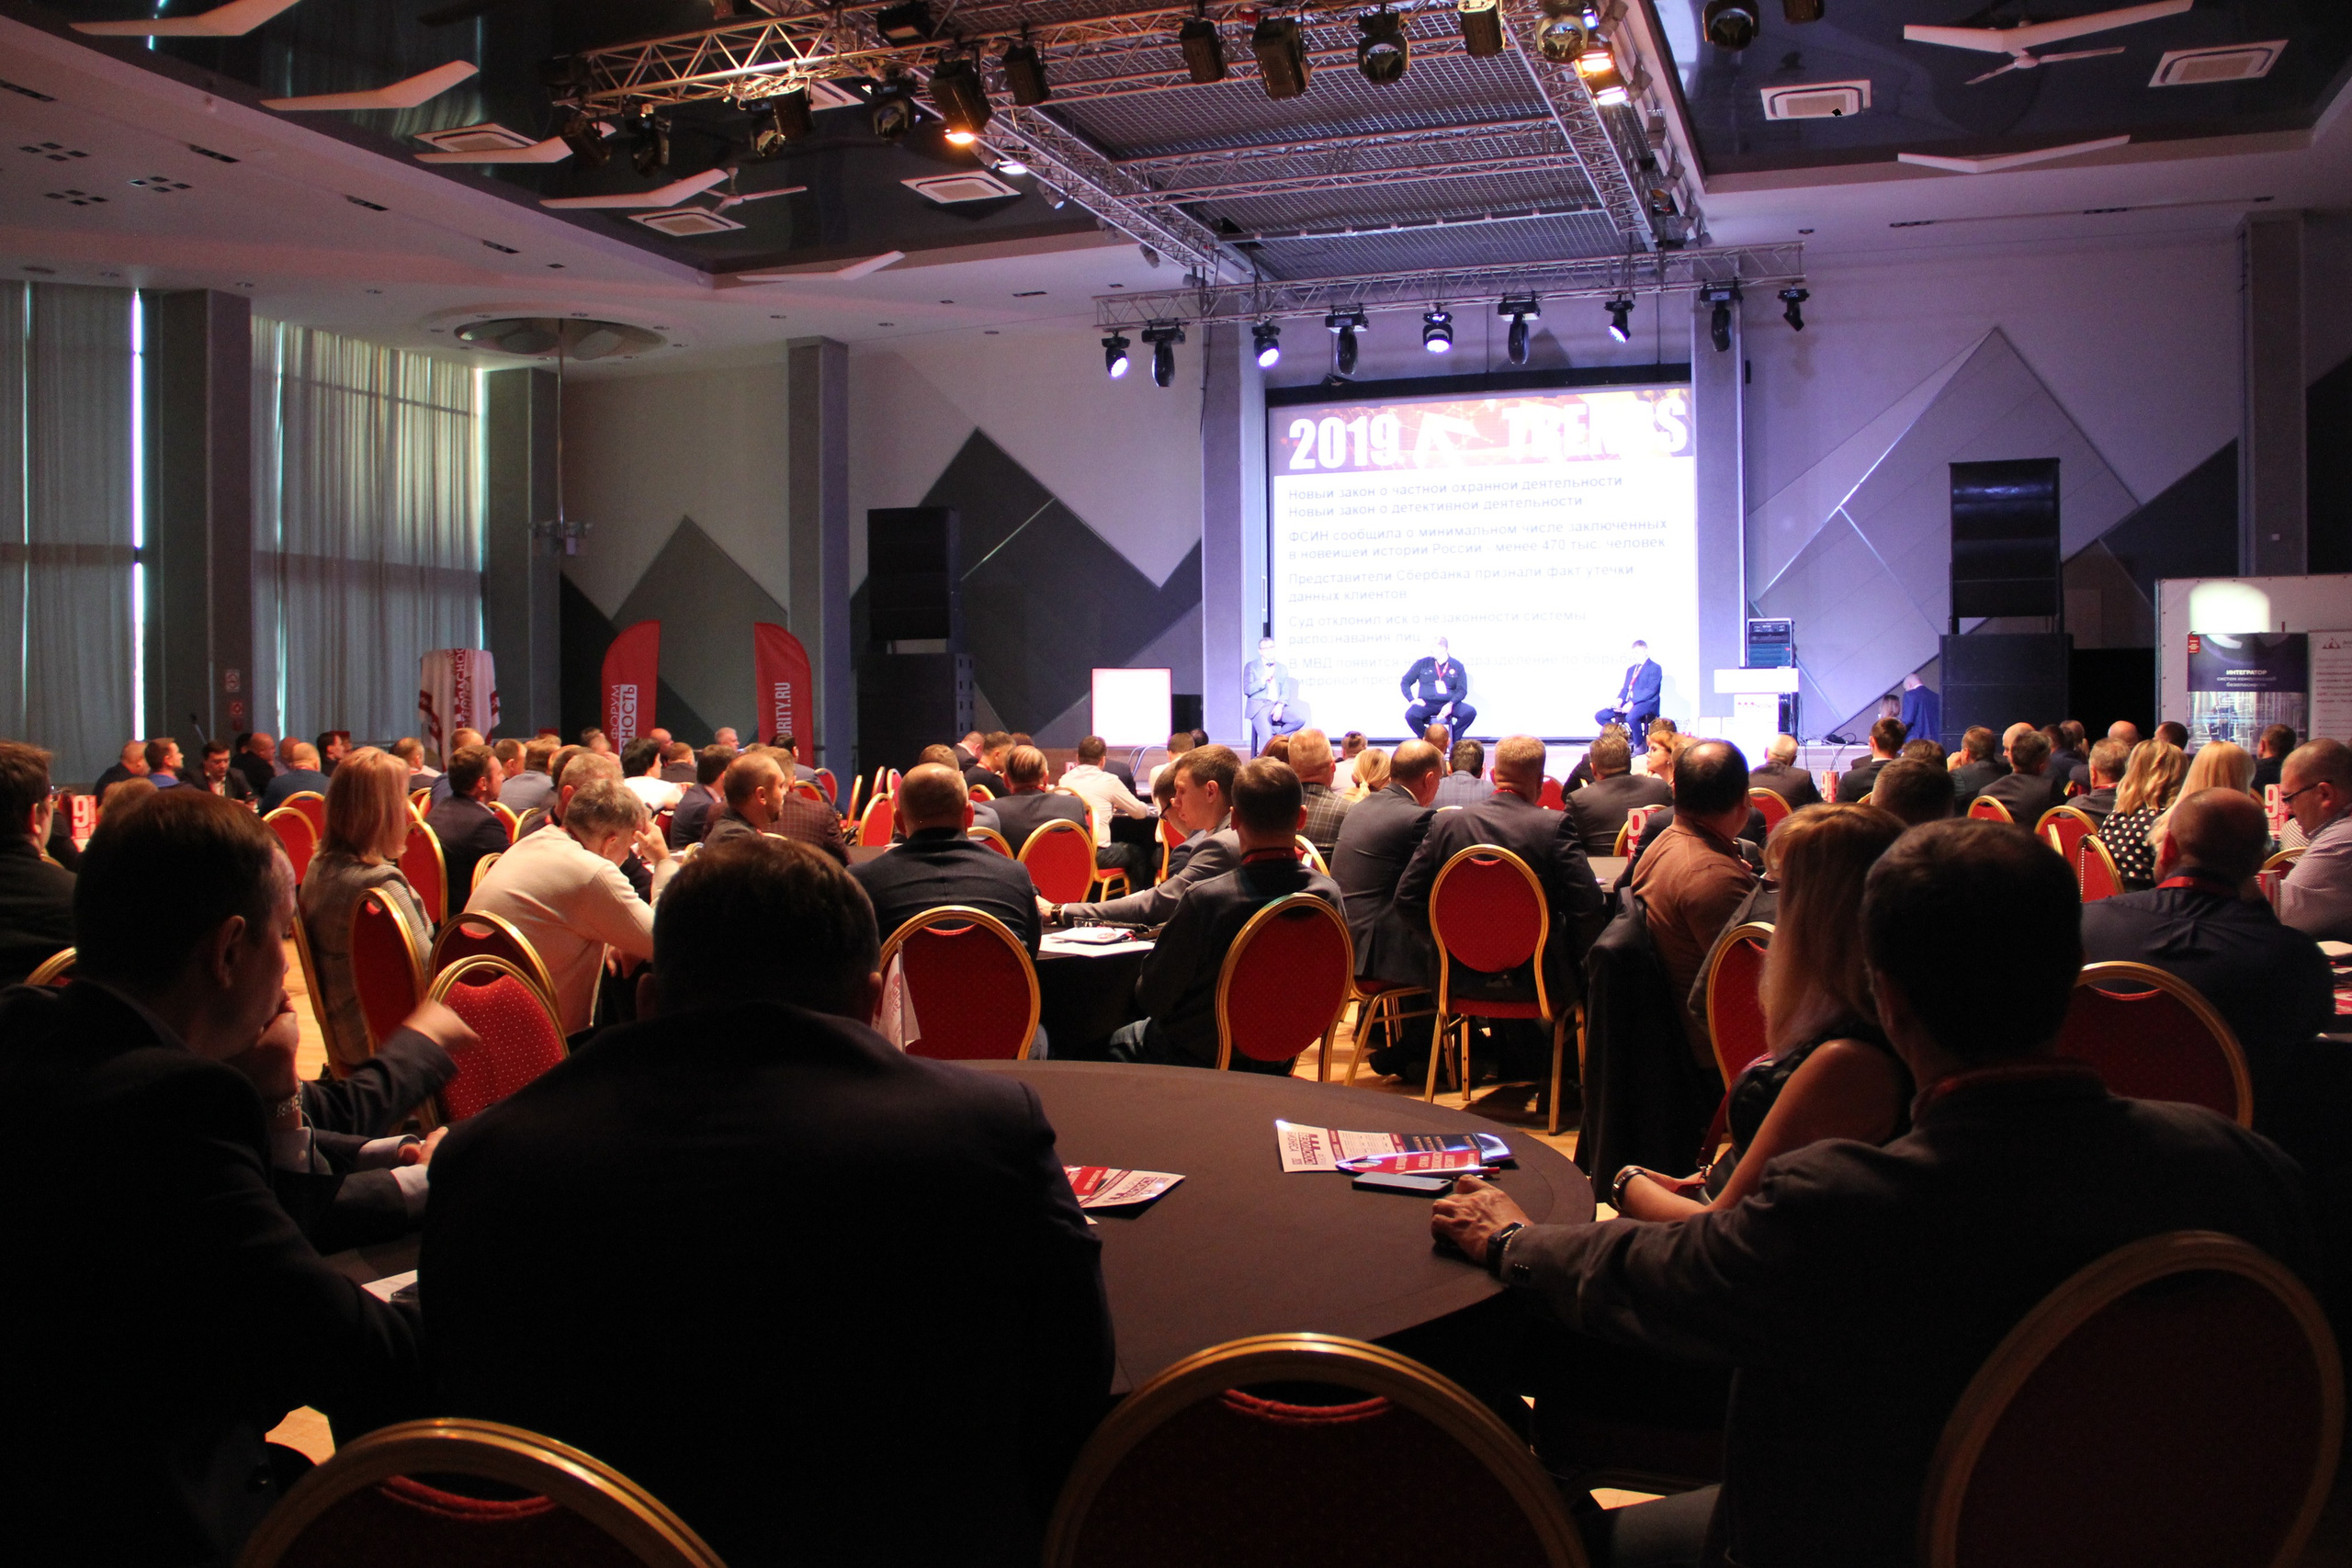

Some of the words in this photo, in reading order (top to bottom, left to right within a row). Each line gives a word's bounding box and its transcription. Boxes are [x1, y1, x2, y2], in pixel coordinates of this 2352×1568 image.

[1501, 399, 1687, 458] TRENS
[1339, 488, 1374, 499] закон
[1521, 476, 1623, 490] деятельности
[1339, 505, 1374, 515] закон
[1484, 496, 1582, 509] деятельности
[1289, 530, 1329, 543] ФСИН
[1333, 528, 1401, 541] сообщила
[1419, 525, 1517, 536] минимальном
[1522, 523, 1563, 534] числе
[1373, 546, 1428, 558] истории
[1432, 543, 1482, 554] России
[1496, 541, 1537, 552] менее
[1542, 538, 1566, 550] 470
[1607, 538, 1666, 549] человек
[1289, 572, 1392, 586] Представители
[1396, 569, 1471, 583] Сбербанка
[1476, 568, 1542, 581] признали
[1587, 565, 1634, 579] утечки
[1289, 592, 1340, 604] данных
[1344, 590, 1408, 601] клиентов
[1289, 615, 1314, 629] Суд
[1318, 615, 1381, 626] отклонил
[1386, 615, 1408, 625] иск
[1523, 610, 1586, 621] системы
[1396, 633, 1420, 643] лиц
[1302, 657, 1332, 670] МВД
[610, 684, 620, 739] ФОРУМ
[2265, 784, 2278, 818] 9
[74, 795, 89, 828] 9
